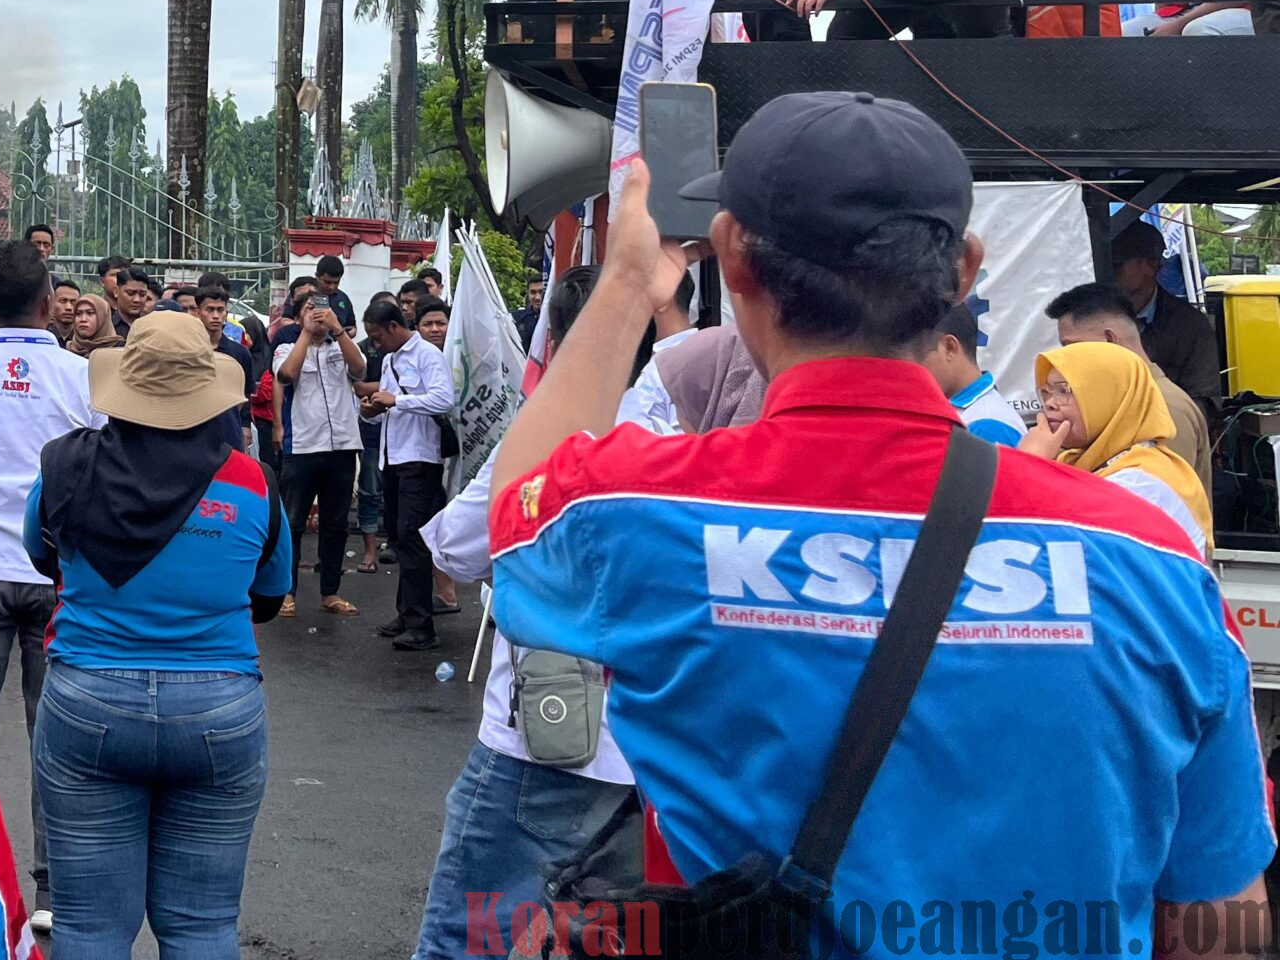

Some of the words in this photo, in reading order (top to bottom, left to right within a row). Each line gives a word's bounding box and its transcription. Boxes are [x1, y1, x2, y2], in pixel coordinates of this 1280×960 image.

[716, 606, 816, 630] Konfederasi
[820, 615, 873, 635] Serikat
[940, 622, 1002, 641] Seluruh
[1007, 623, 1084, 642] Indonesia
[1237, 607, 1280, 628] CL
